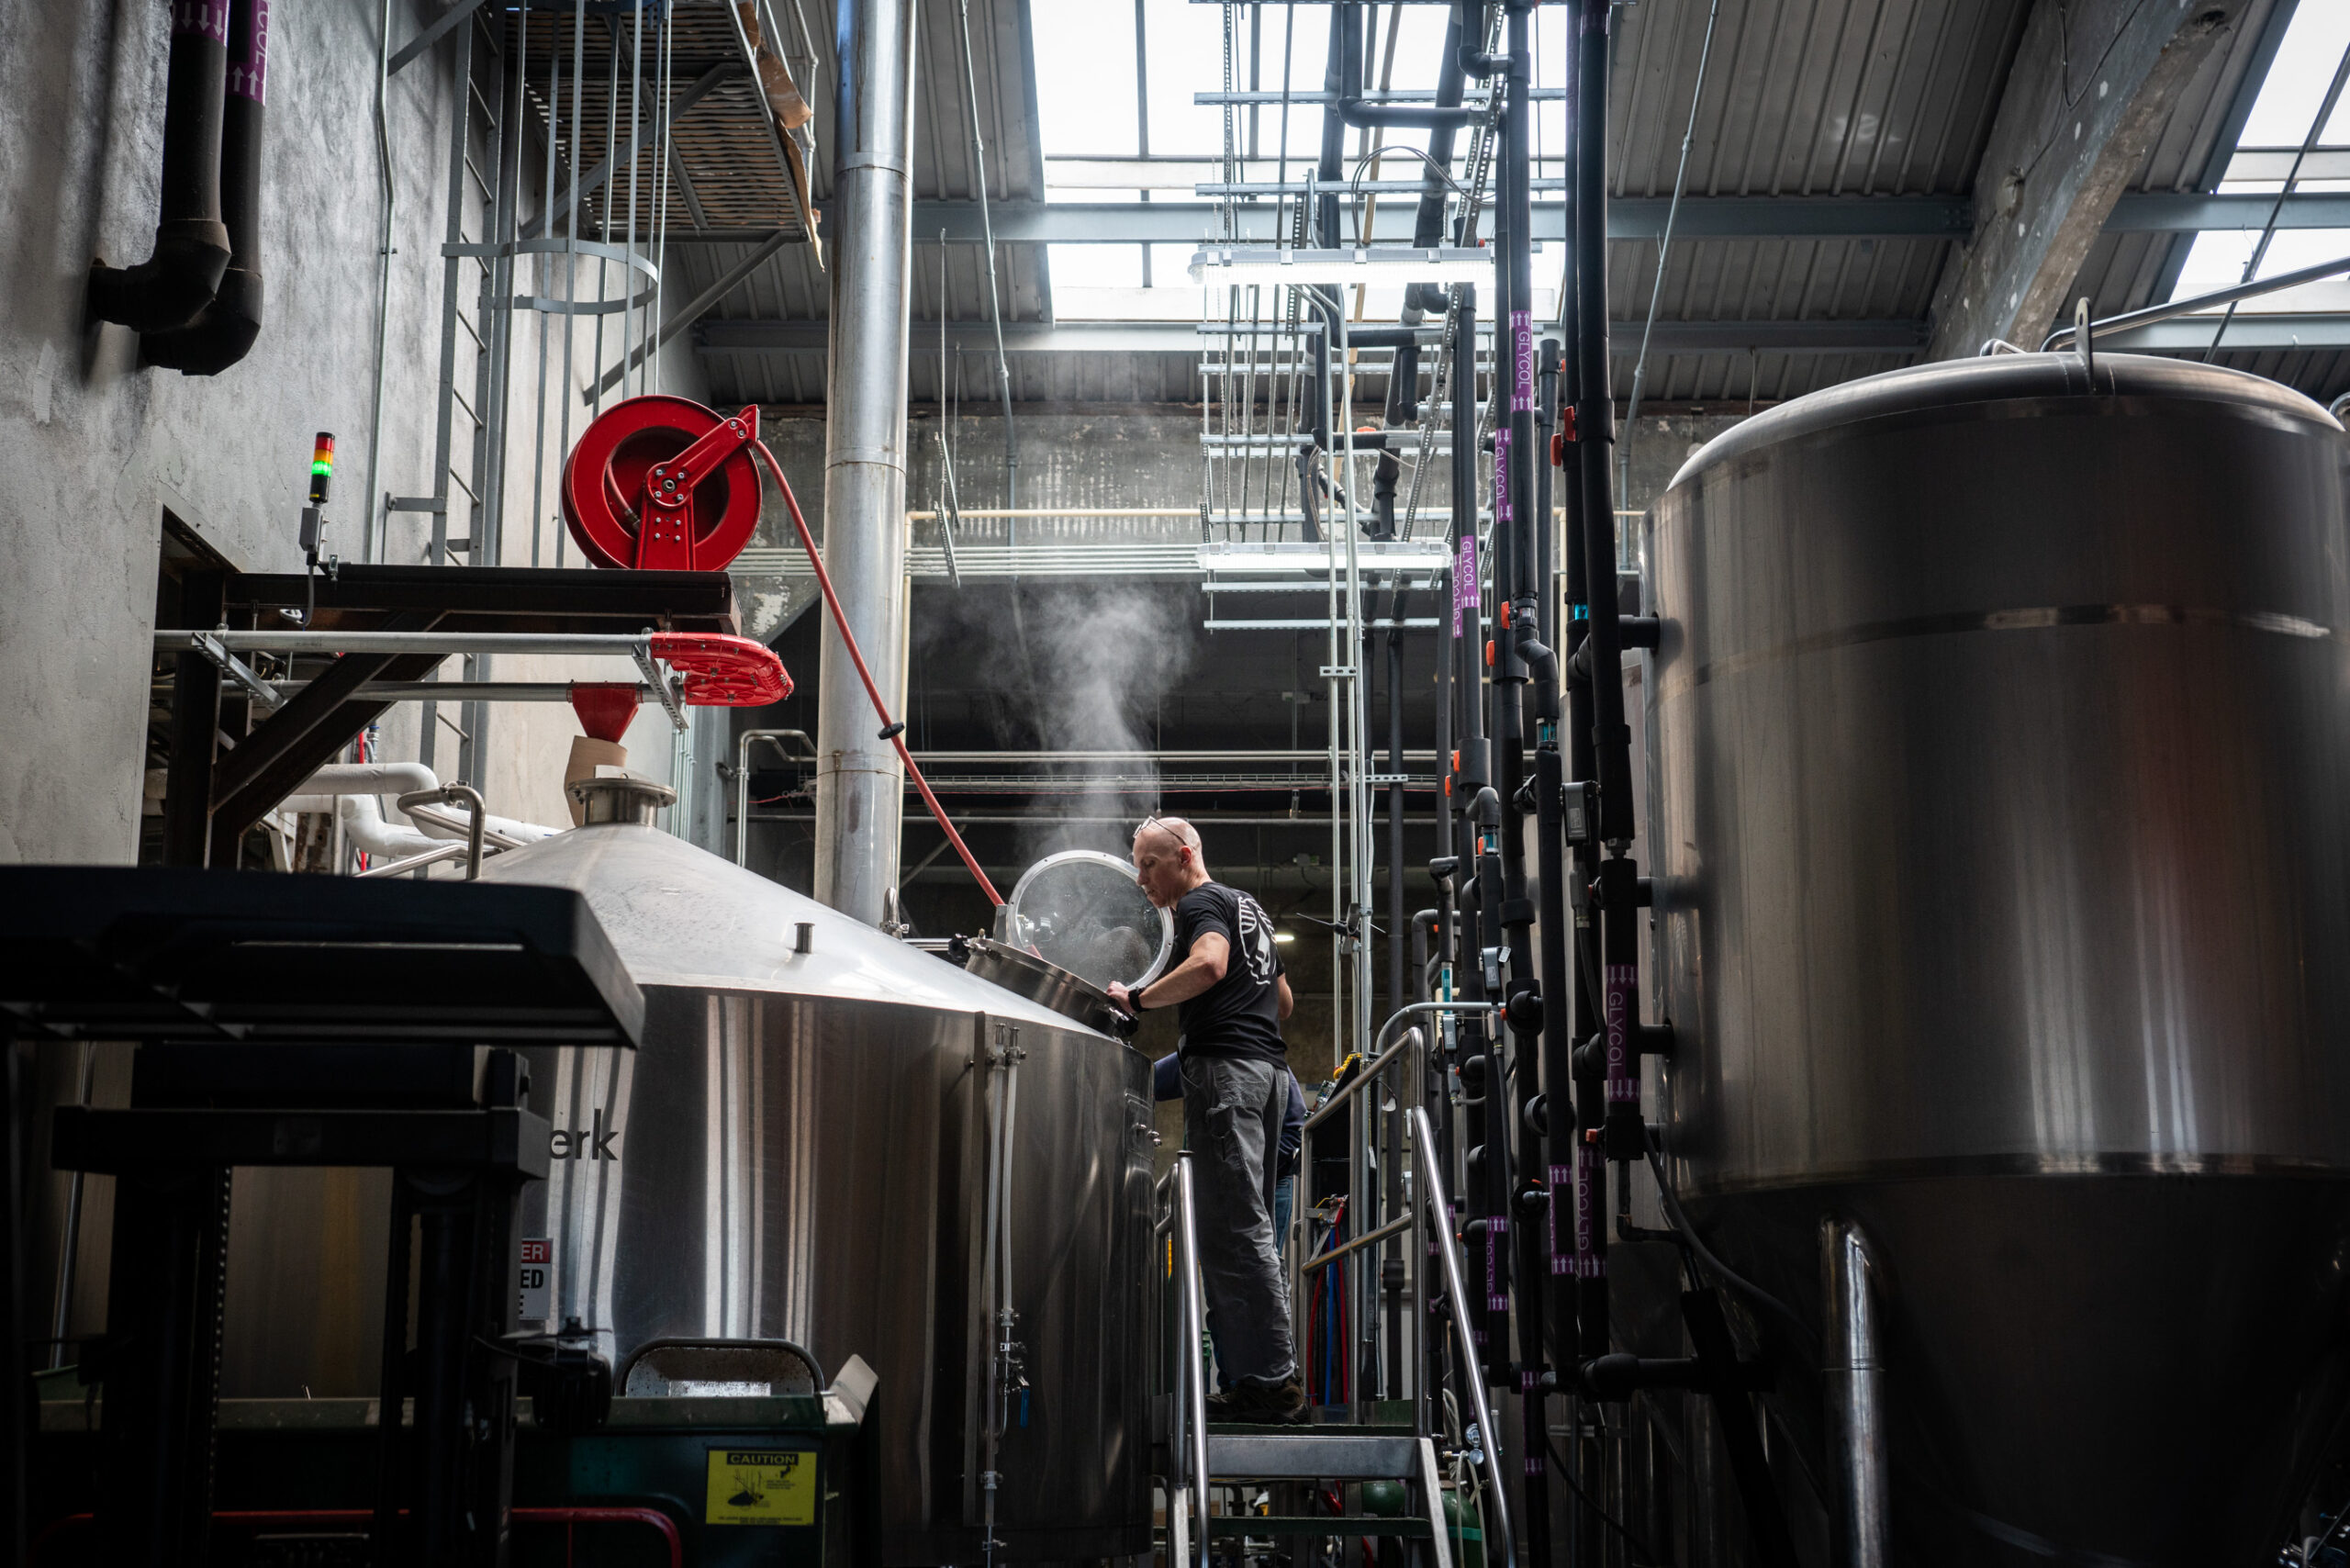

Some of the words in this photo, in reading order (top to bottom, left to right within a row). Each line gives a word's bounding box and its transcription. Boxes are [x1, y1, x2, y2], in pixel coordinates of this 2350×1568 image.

[1518, 331, 1530, 389] GLYCOL
[1495, 446, 1505, 499] GLYCOL
[1462, 541, 1474, 590] GLYCOL
[1452, 572, 1460, 621] GLYCOL
[1608, 991, 1623, 1073] GLYCOL
[1579, 1170, 1589, 1250] GLYCOL
[730, 1454, 795, 1464] CAUTION
